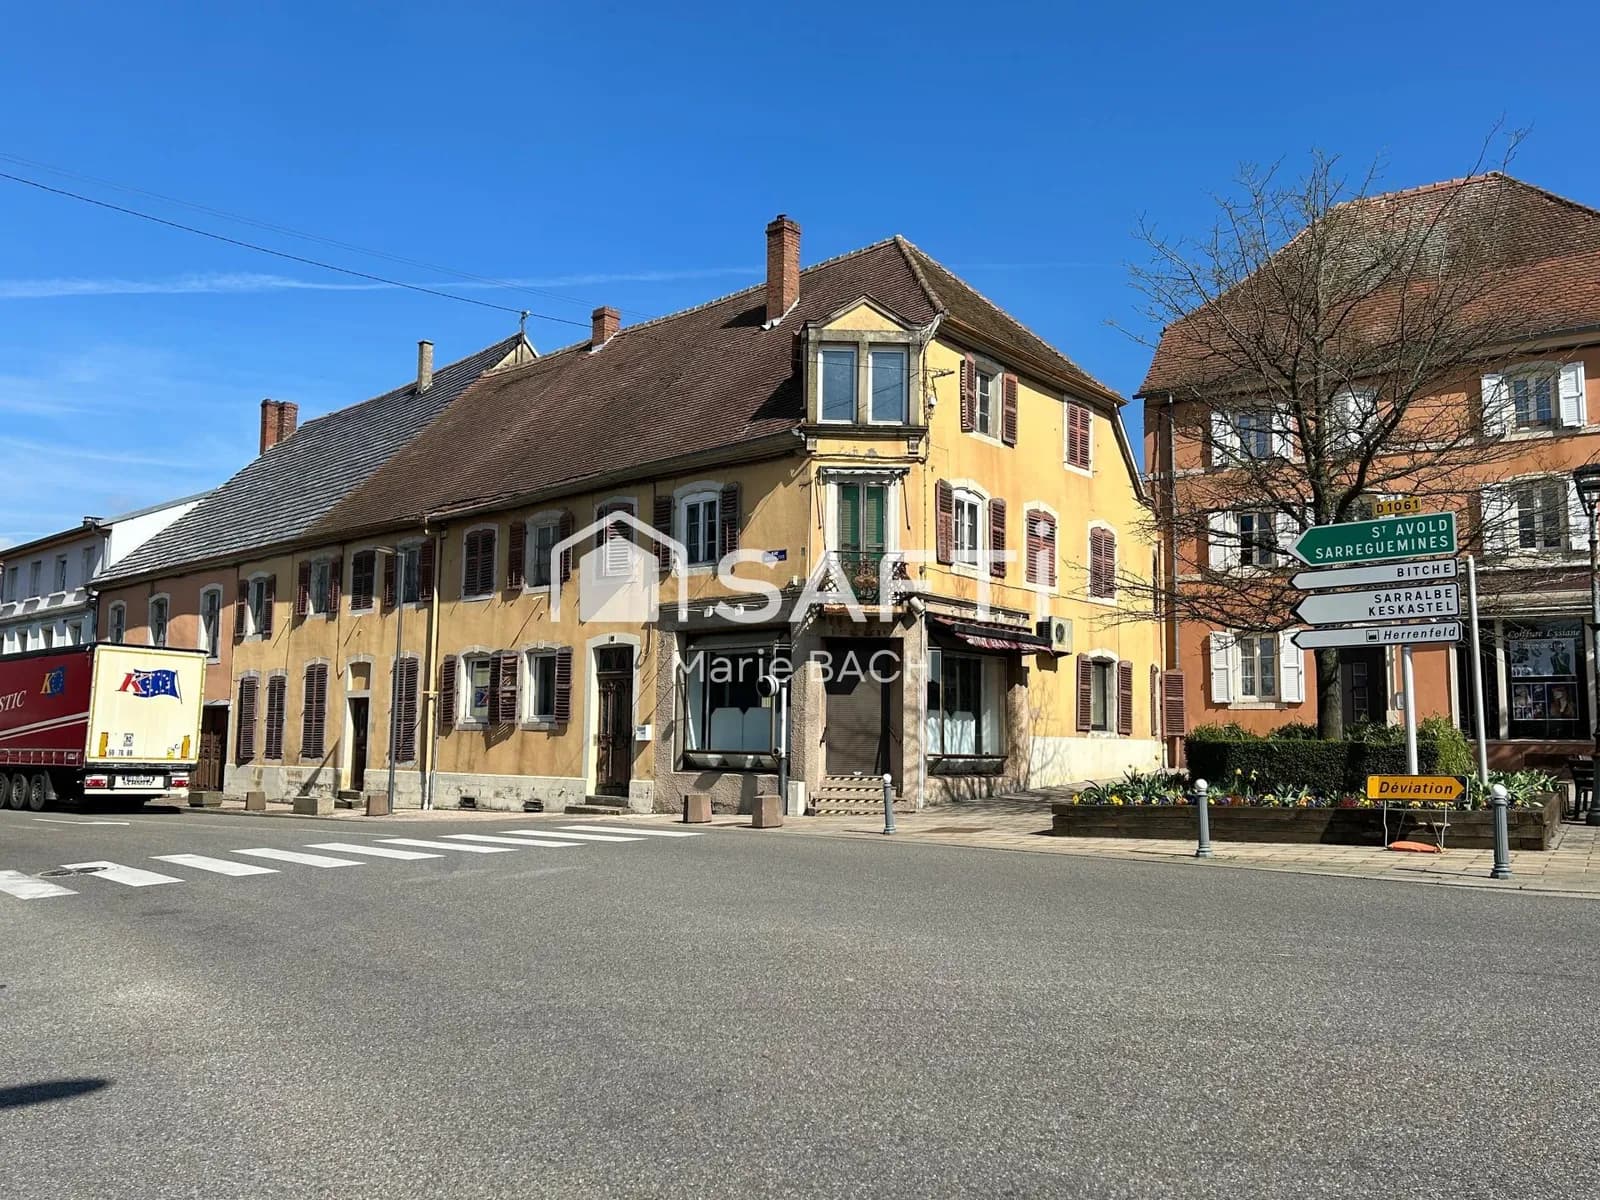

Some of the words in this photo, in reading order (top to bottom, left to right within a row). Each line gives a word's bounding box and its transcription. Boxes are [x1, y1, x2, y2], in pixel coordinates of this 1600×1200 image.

[1395, 519, 1448, 536] AVOLD
[1315, 535, 1449, 559] SARREGUEMINES
[1397, 563, 1452, 577] BITCHE
[1374, 588, 1453, 604] SARRALBE
[1368, 601, 1454, 617] KESKASTEL
[1383, 626, 1456, 640] Herrenfeld
[1379, 780, 1453, 795] Déviation
